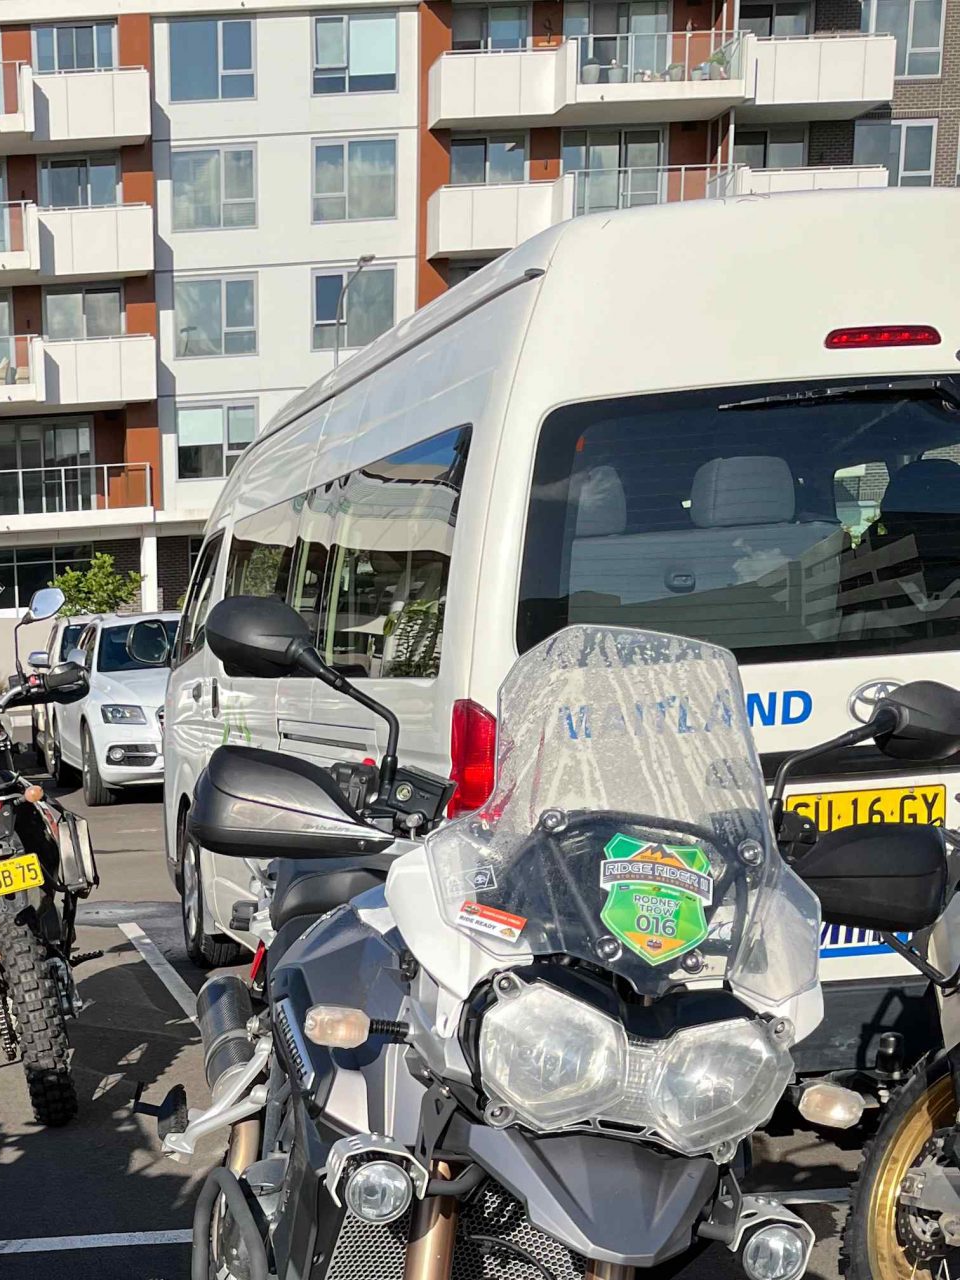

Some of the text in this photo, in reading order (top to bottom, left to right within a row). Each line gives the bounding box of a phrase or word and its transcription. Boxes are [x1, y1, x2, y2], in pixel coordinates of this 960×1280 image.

[15, 862, 39, 884] 75
[605, 862, 653, 876] RIDGE
[654, 864, 699, 888] RIDER
[633, 894, 681, 909] RODNEY
[640, 904, 674, 917] TROW
[459, 915, 475, 924] RIDE
[474, 919, 498, 930] READY
[635, 914, 676, 938] 016
[277, 1004, 308, 1081] TRIUMPH
